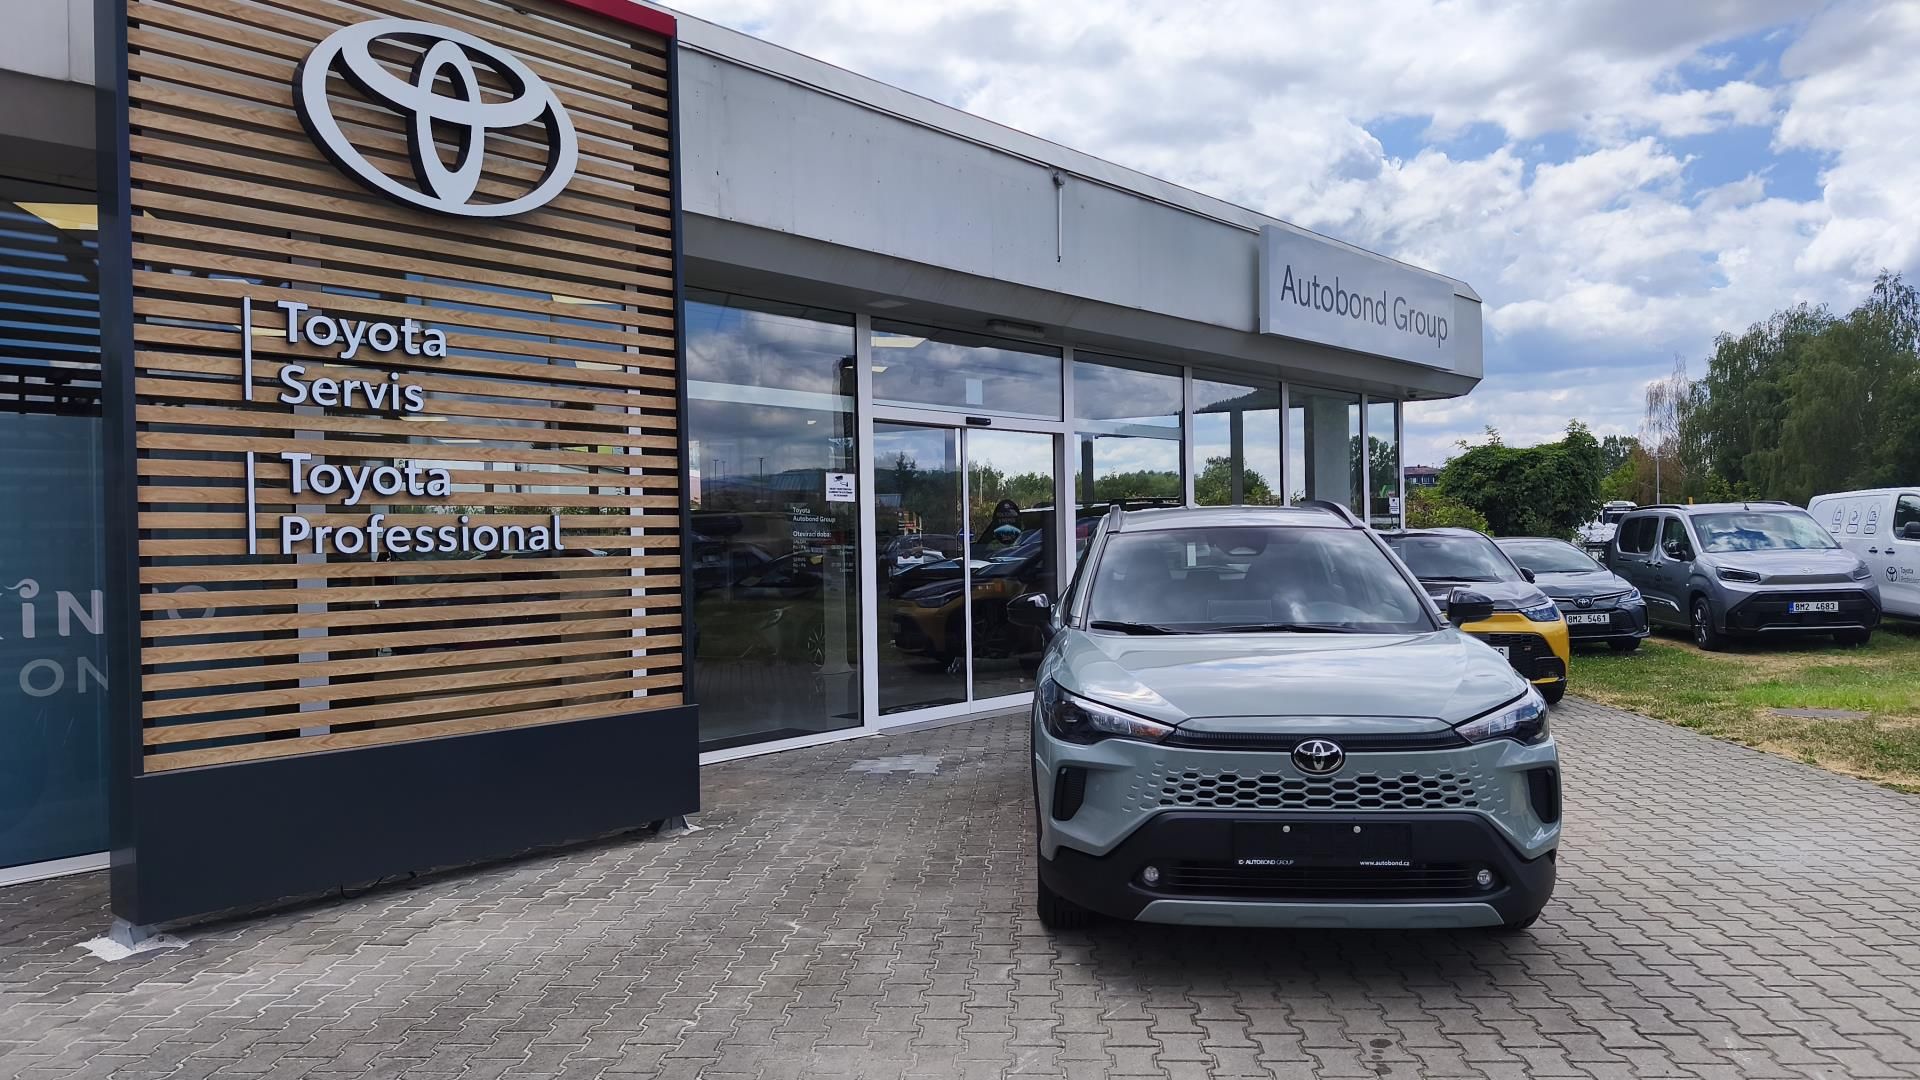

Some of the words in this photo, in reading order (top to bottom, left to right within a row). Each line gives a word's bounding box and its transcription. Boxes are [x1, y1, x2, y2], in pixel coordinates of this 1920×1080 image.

[277, 299, 448, 359] Toyota
[1280, 264, 1387, 327] Autobond
[1393, 296, 1448, 349] Group
[279, 364, 425, 412] Servis
[280, 451, 451, 505] Toyota
[792, 506, 811, 515] Toyota
[819, 516, 836, 524] Group
[280, 513, 565, 555] Professional
[1587, 614, 1606, 623] 5461
